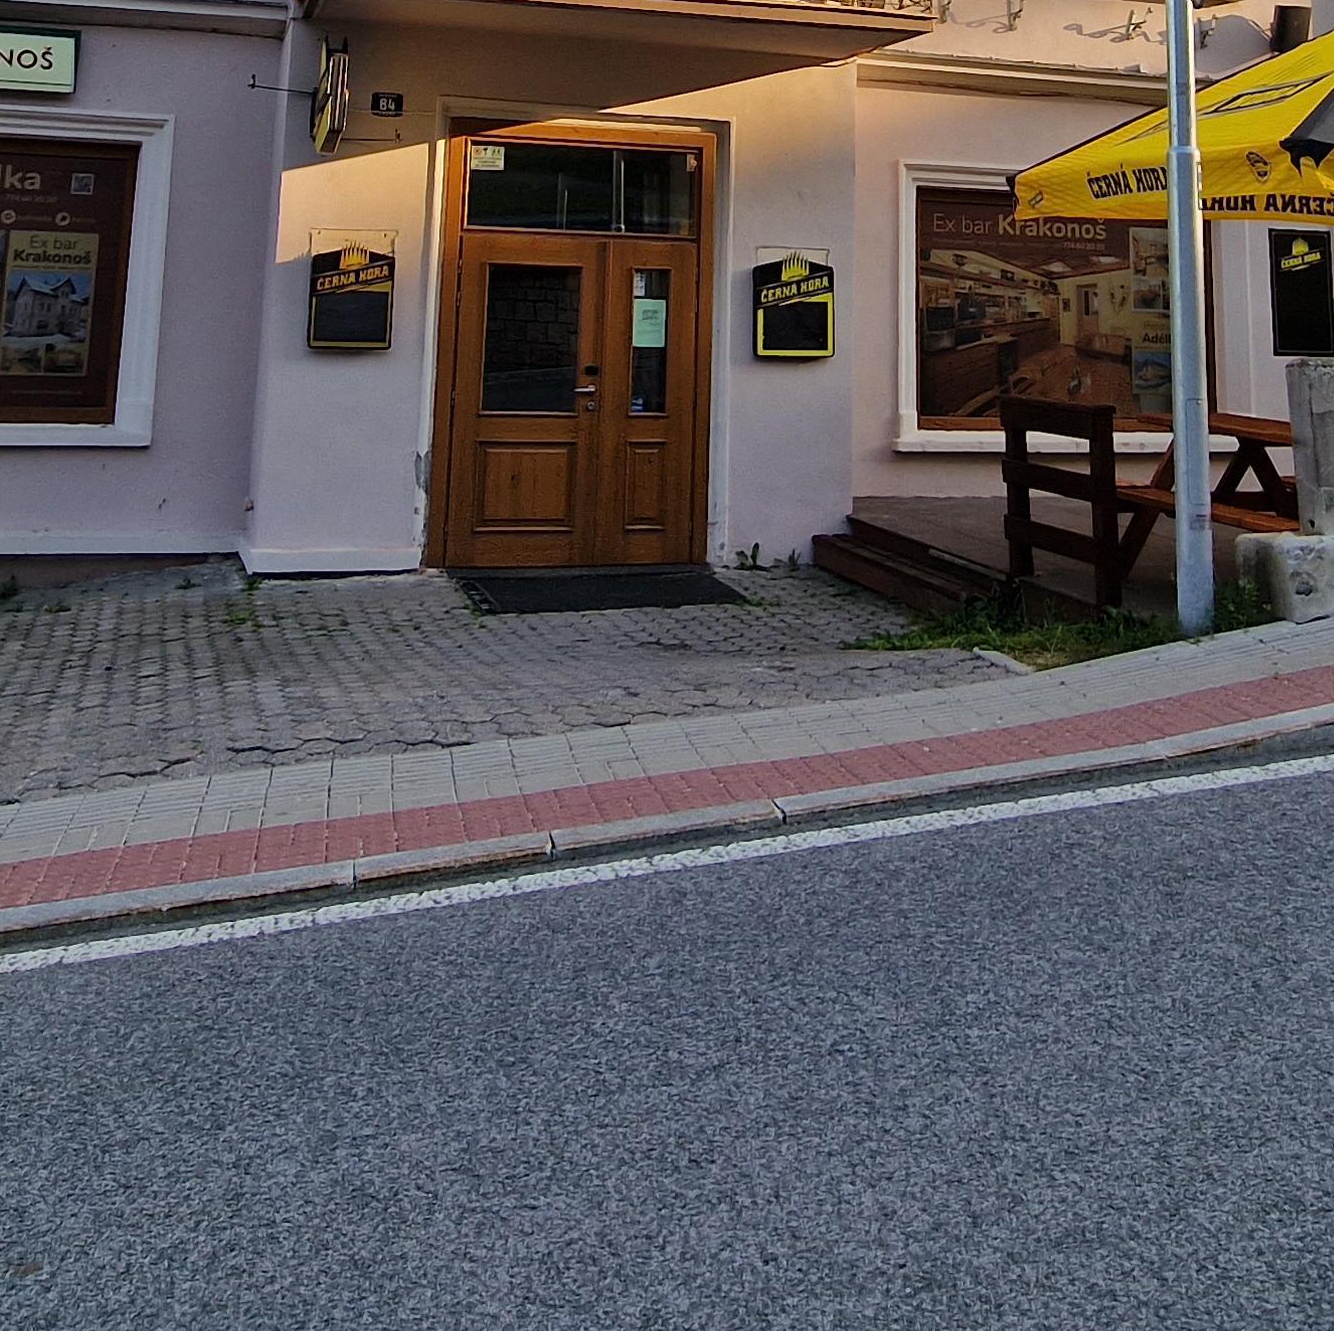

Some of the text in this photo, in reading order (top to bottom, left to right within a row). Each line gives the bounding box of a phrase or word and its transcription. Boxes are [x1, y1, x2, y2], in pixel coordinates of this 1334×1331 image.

[932, 213, 1107, 241] Ex bar Krakonoš
[29, 235, 79, 251] Ex bar
[13, 249, 92, 266] Krakonoš
[358, 265, 389, 282] HORA
[800, 276, 830, 294] HORA
